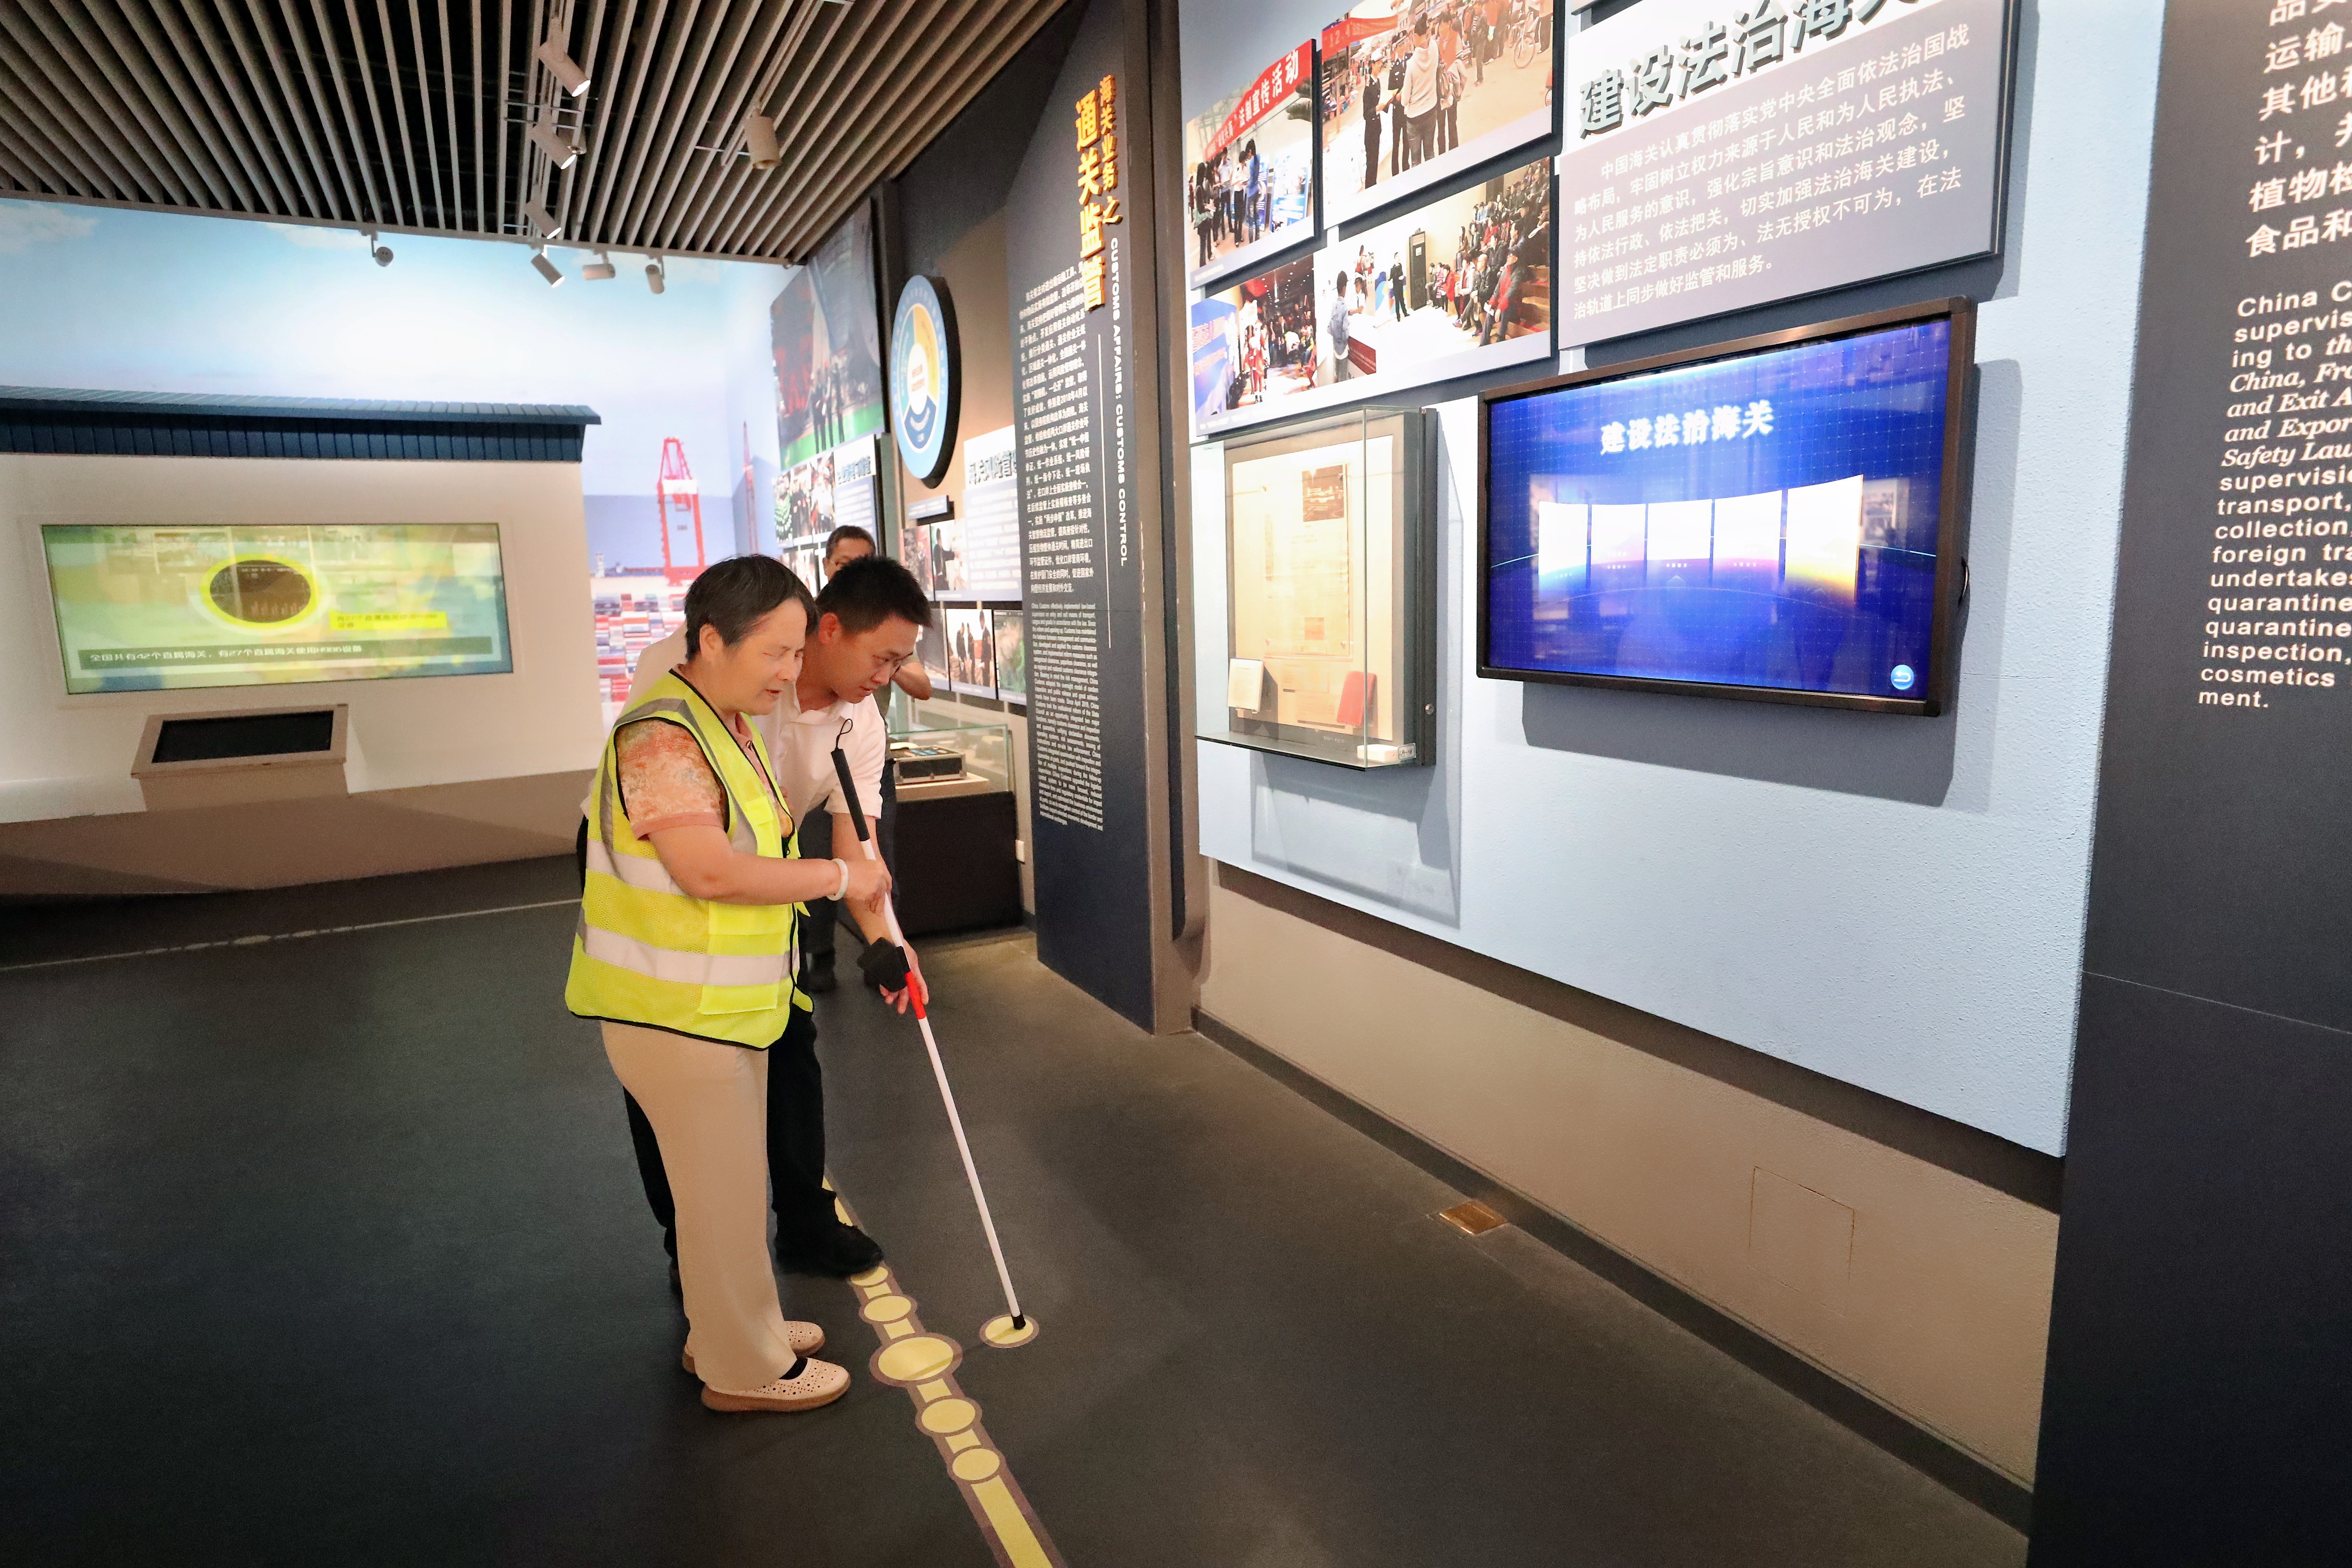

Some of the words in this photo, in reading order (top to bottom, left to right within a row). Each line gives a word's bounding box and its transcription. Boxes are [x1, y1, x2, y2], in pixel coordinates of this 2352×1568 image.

[2269, 0, 2347, 27] 品
[1580, 0, 1919, 138] 建设法治海
[2263, 21, 2352, 74] 运输
[1602, 24, 1969, 181] 中国海关认真贯彻落实党中央全面依法治国战
[2259, 64, 2352, 121] 其他
[1100, 74, 1123, 224] 海关业务之
[1574, 69, 1956, 216] 略布局，牢固树立权力来源于人民和为人民执法、
[1575, 96, 1966, 242] 为人民服务的意识，强化宗旨意识和法治观念，坚
[1075, 89, 1105, 311] 通关监管
[1574, 139, 1950, 269] 持依法行政、依法把关，切实加强法治海关建设，
[1574, 166, 1961, 294] 坚决做到法定职责必须为、法无授权不可为，在法
[2245, 208, 2352, 257] 食品和
[1111, 237, 1120, 320] CUSTOMS
[1574, 255, 1773, 320] 治轨道上同步做好监管和服务。
[2234, 308, 2352, 343] supervis
[2237, 290, 2318, 317] China
[1113, 325, 1123, 399] AFFAIRS:
[2232, 349, 2272, 369] ing
[2285, 342, 2312, 361] to
[2325, 332, 2352, 355] th
[2226, 394, 2274, 419] and
[2276, 389, 2330, 412] Exit
[2230, 370, 2306, 393] China,
[1116, 404, 1125, 484] CUSTOMS
[1601, 400, 1774, 455] 建设法治海关
[2224, 420, 2272, 442] and
[2277, 416, 2352, 440] Expor
[2220, 444, 2297, 469] Safety
[1118, 489, 1128, 567] CONTROL
[2217, 491, 2351, 516] transport,
[2215, 518, 2352, 539] collection
[2212, 544, 2306, 567] foreign
[2205, 618, 2352, 638] quarantine
[2208, 593, 2352, 615] quarantine
[2201, 668, 2335, 687] cosmetics
[2203, 641, 2351, 665] inspection,
[2199, 691, 2268, 707] ment.
